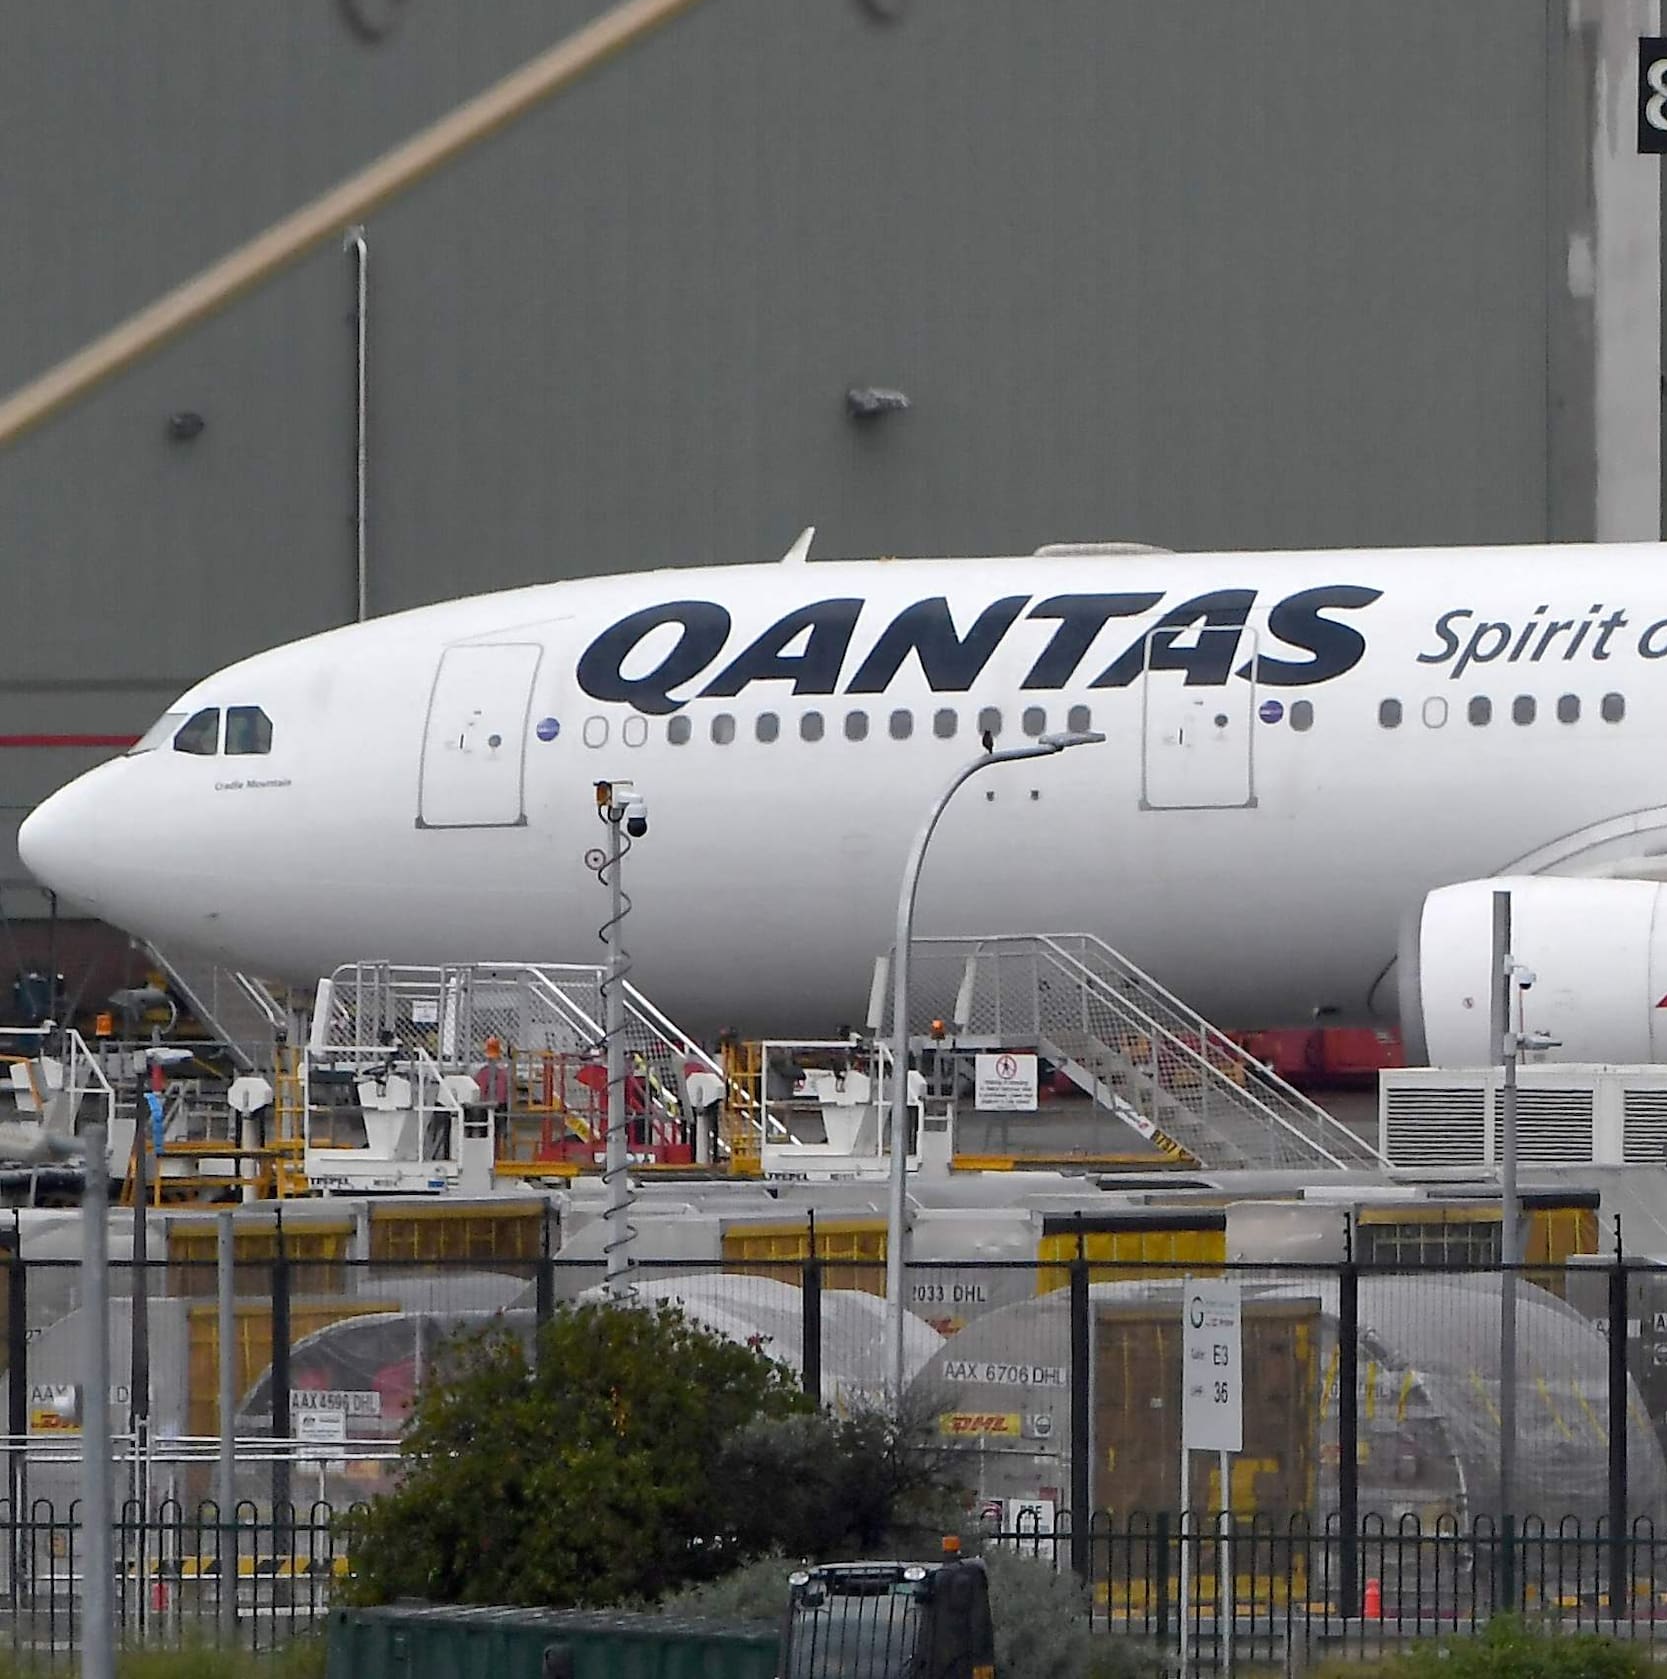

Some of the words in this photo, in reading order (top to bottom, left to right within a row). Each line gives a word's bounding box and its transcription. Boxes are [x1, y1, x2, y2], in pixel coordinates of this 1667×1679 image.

[576, 585, 1384, 716] QANTAS
[1416, 603, 1627, 680] Spirit
[953, 1285, 986, 1303] DHL
[1213, 1345, 1229, 1366] E3
[944, 1362, 977, 1380] AAX
[986, 1365, 1029, 1384] 6706
[1031, 1367, 1066, 1386] DHL
[950, 1416, 1009, 1432] DHL
